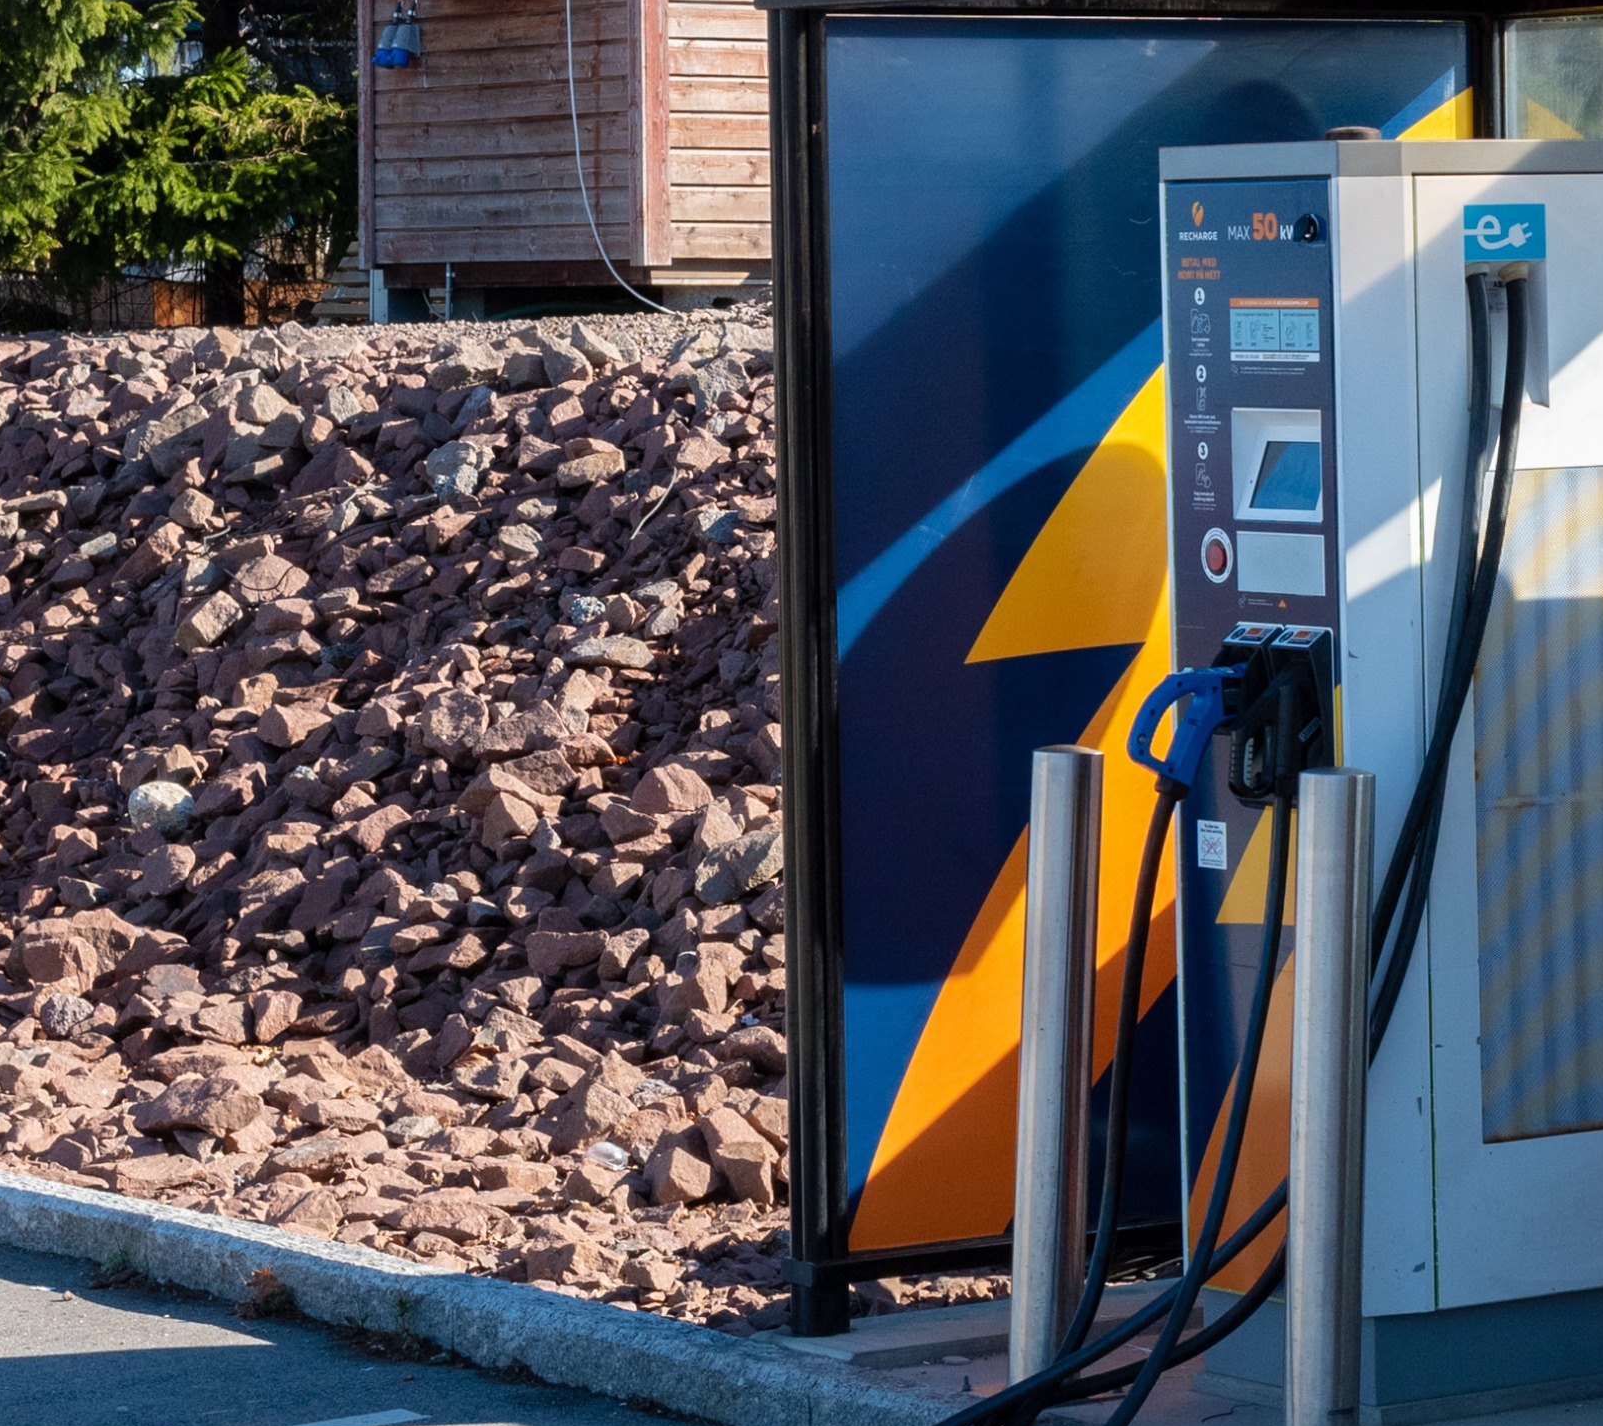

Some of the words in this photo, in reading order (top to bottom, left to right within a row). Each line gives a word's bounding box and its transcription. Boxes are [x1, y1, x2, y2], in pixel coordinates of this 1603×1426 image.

[1178, 231, 1218, 241] RECHARGE
[1227, 225, 1251, 240] MAX
[1252, 212, 1278, 241] 50
